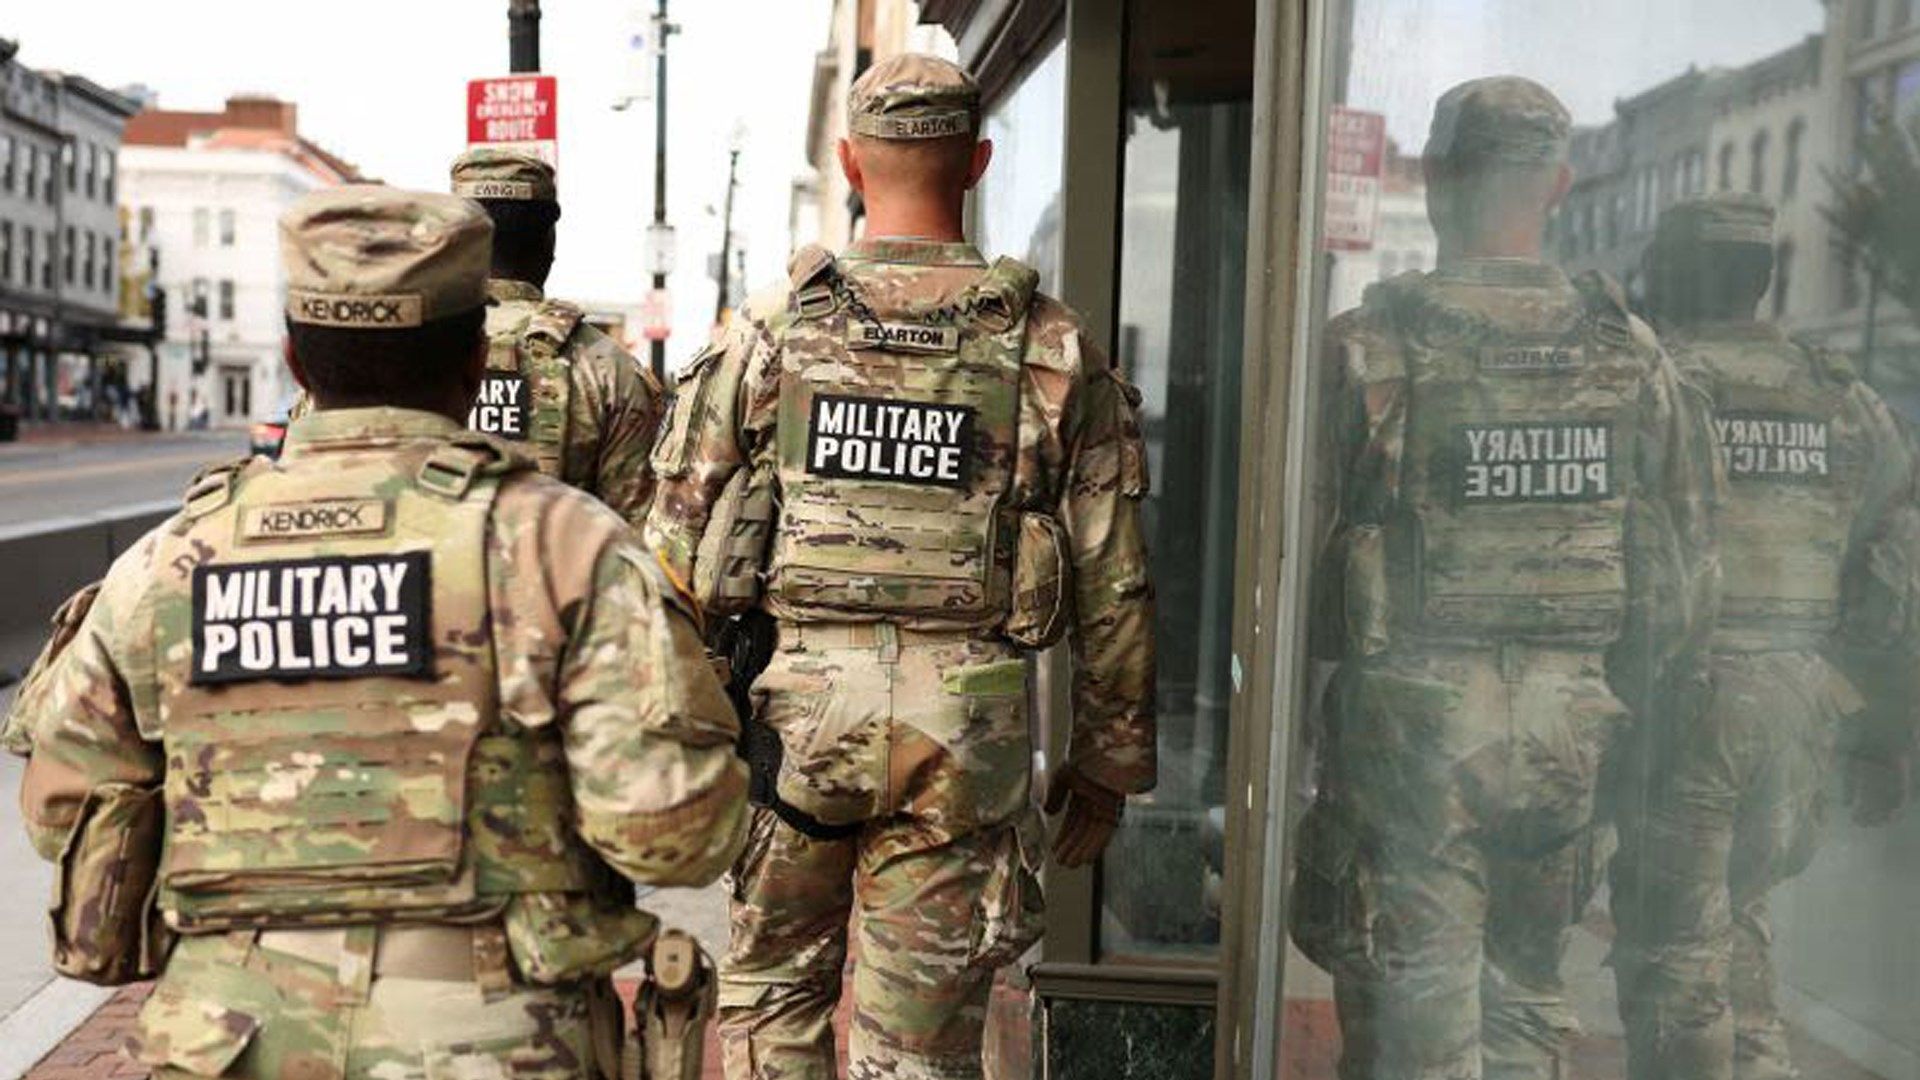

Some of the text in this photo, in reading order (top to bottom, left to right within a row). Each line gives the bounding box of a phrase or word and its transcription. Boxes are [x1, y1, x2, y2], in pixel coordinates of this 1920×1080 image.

[484, 81, 538, 102] SNOW
[486, 118, 537, 139] ROUTE
[301, 298, 402, 322] KENDRICK
[864, 327, 944, 345] ELARTON
[468, 406, 520, 432] ICE
[817, 400, 965, 444] MILITARY
[814, 436, 960, 480] POLICE
[260, 505, 363, 532] KENDRICK
[205, 562, 408, 622] MILITARY
[202, 614, 409, 672] POLICE
